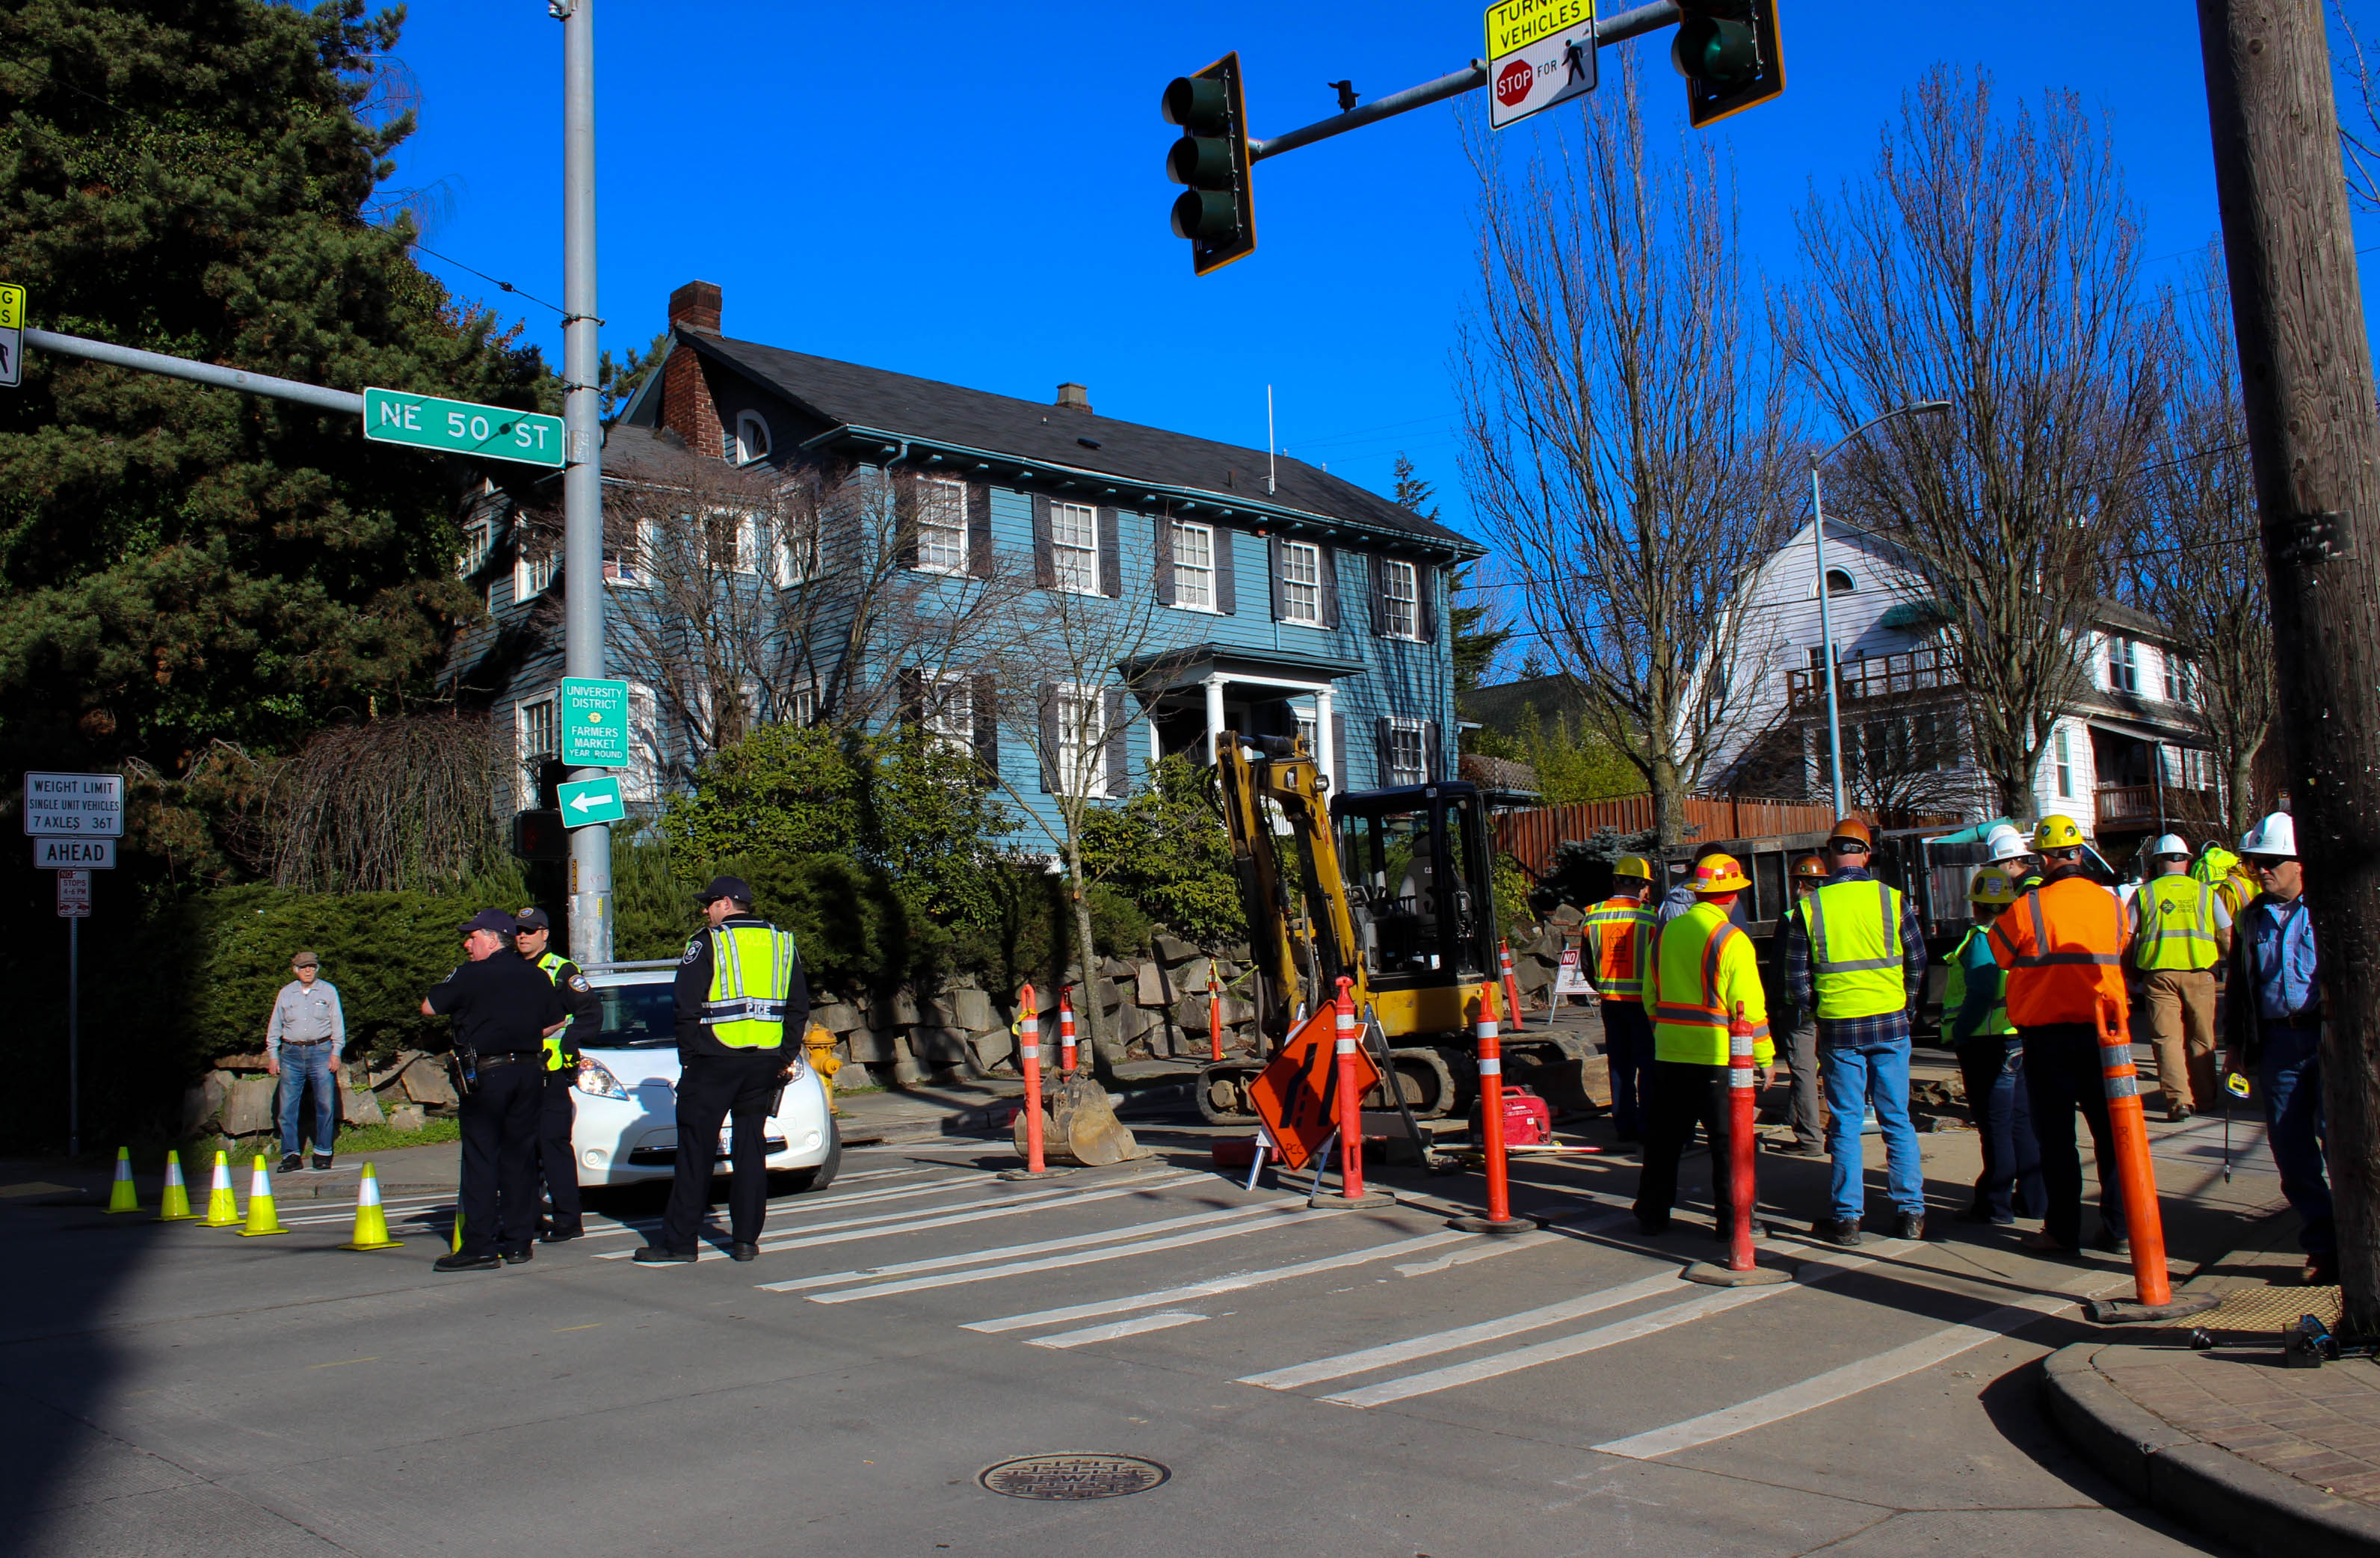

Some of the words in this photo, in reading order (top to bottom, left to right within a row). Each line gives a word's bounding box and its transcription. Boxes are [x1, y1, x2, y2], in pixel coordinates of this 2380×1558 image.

[1501, 1, 1580, 49] VEHICLES
[1498, 69, 1532, 96] STOP
[1538, 60, 1557, 78] FOR
[380, 401, 422, 431] NE
[448, 412, 490, 441] 50
[515, 422, 549, 449] ST
[567, 686, 623, 698] UNIVERSITY
[572, 698, 617, 709] DISTRICT
[571, 726, 619, 737] FARMERS
[574, 738, 616, 749] MARKET
[594, 750, 623, 759] ROUND
[34, 780, 78, 792] WEIGHT
[84, 782, 114, 794] LIMIT
[30, 798, 58, 810] SINGLE
[61, 799, 80, 810] UNIT
[82, 800, 120, 811] VEHICLES
[34, 816, 41, 827] 7
[44, 816, 80, 829] AXLES
[92, 817, 113, 828] 36T
[46, 843, 104, 861] AHEAD
[1563, 952, 1576, 964] NO
